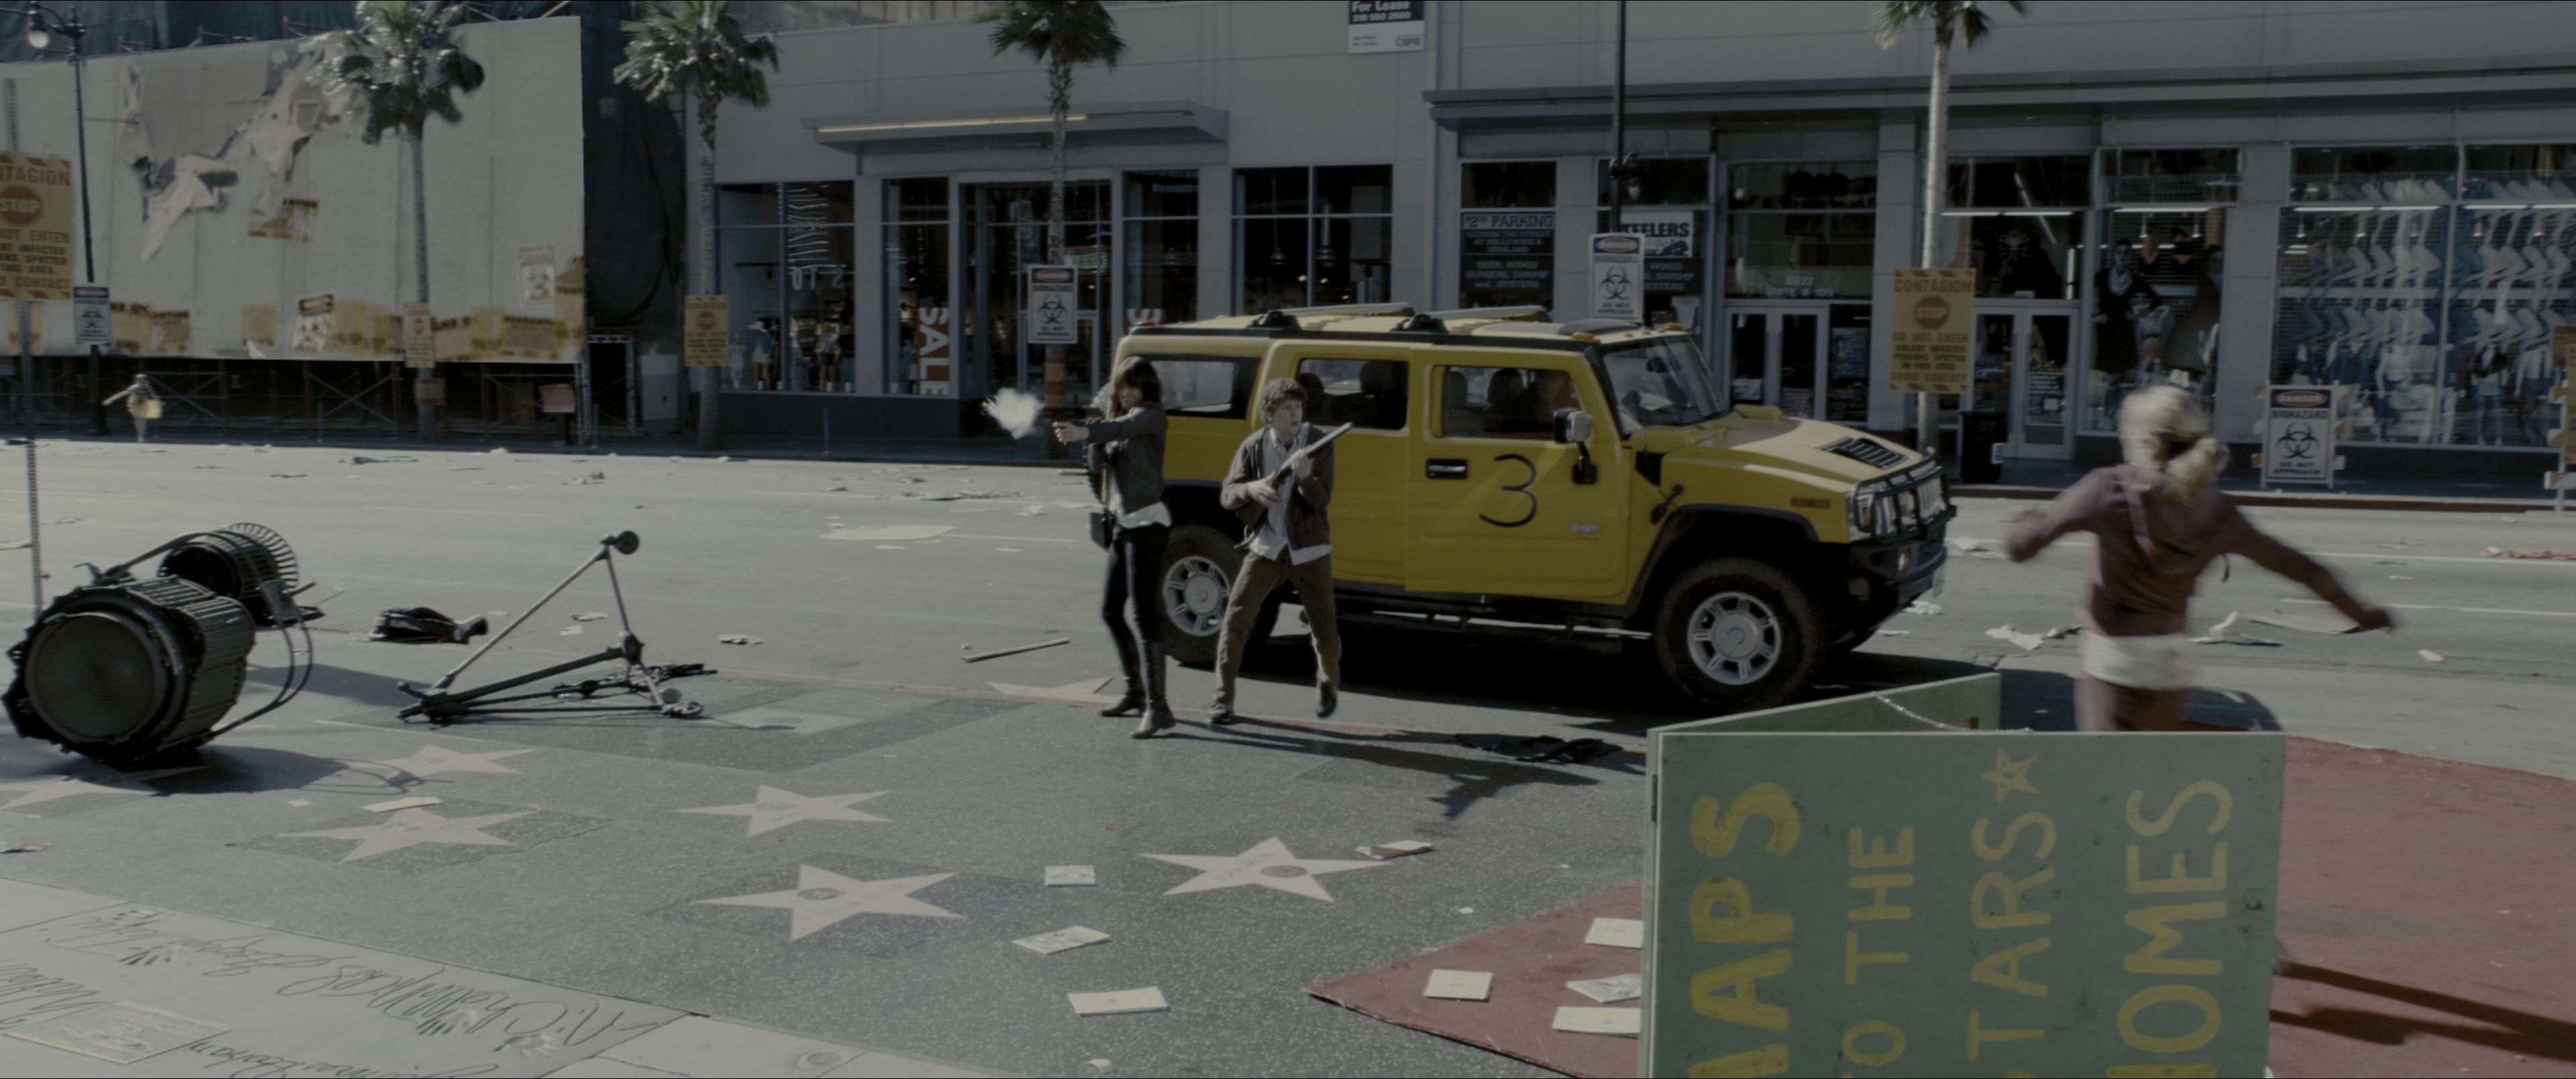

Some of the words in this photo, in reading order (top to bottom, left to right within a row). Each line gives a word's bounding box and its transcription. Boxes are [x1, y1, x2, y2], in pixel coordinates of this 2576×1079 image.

[1352, 1, 1372, 12] For
[0, 198, 40, 213] STOP
[1491, 215, 1553, 227] PARKING
[1620, 222, 1690, 238] TEELERS
[1894, 278, 1972, 293] CONTAGION
[1916, 306, 1946, 319] STOP
[918, 307, 950, 395] SALE
[2271, 410, 2328, 419] BIOHAZARD
[1479, 454, 1538, 527] 3
[1844, 826, 1914, 986] THE
[2106, 778, 2233, 1078] OMES
[1966, 811, 2057, 1078] TARS
[1841, 1019, 1907, 1078] O
